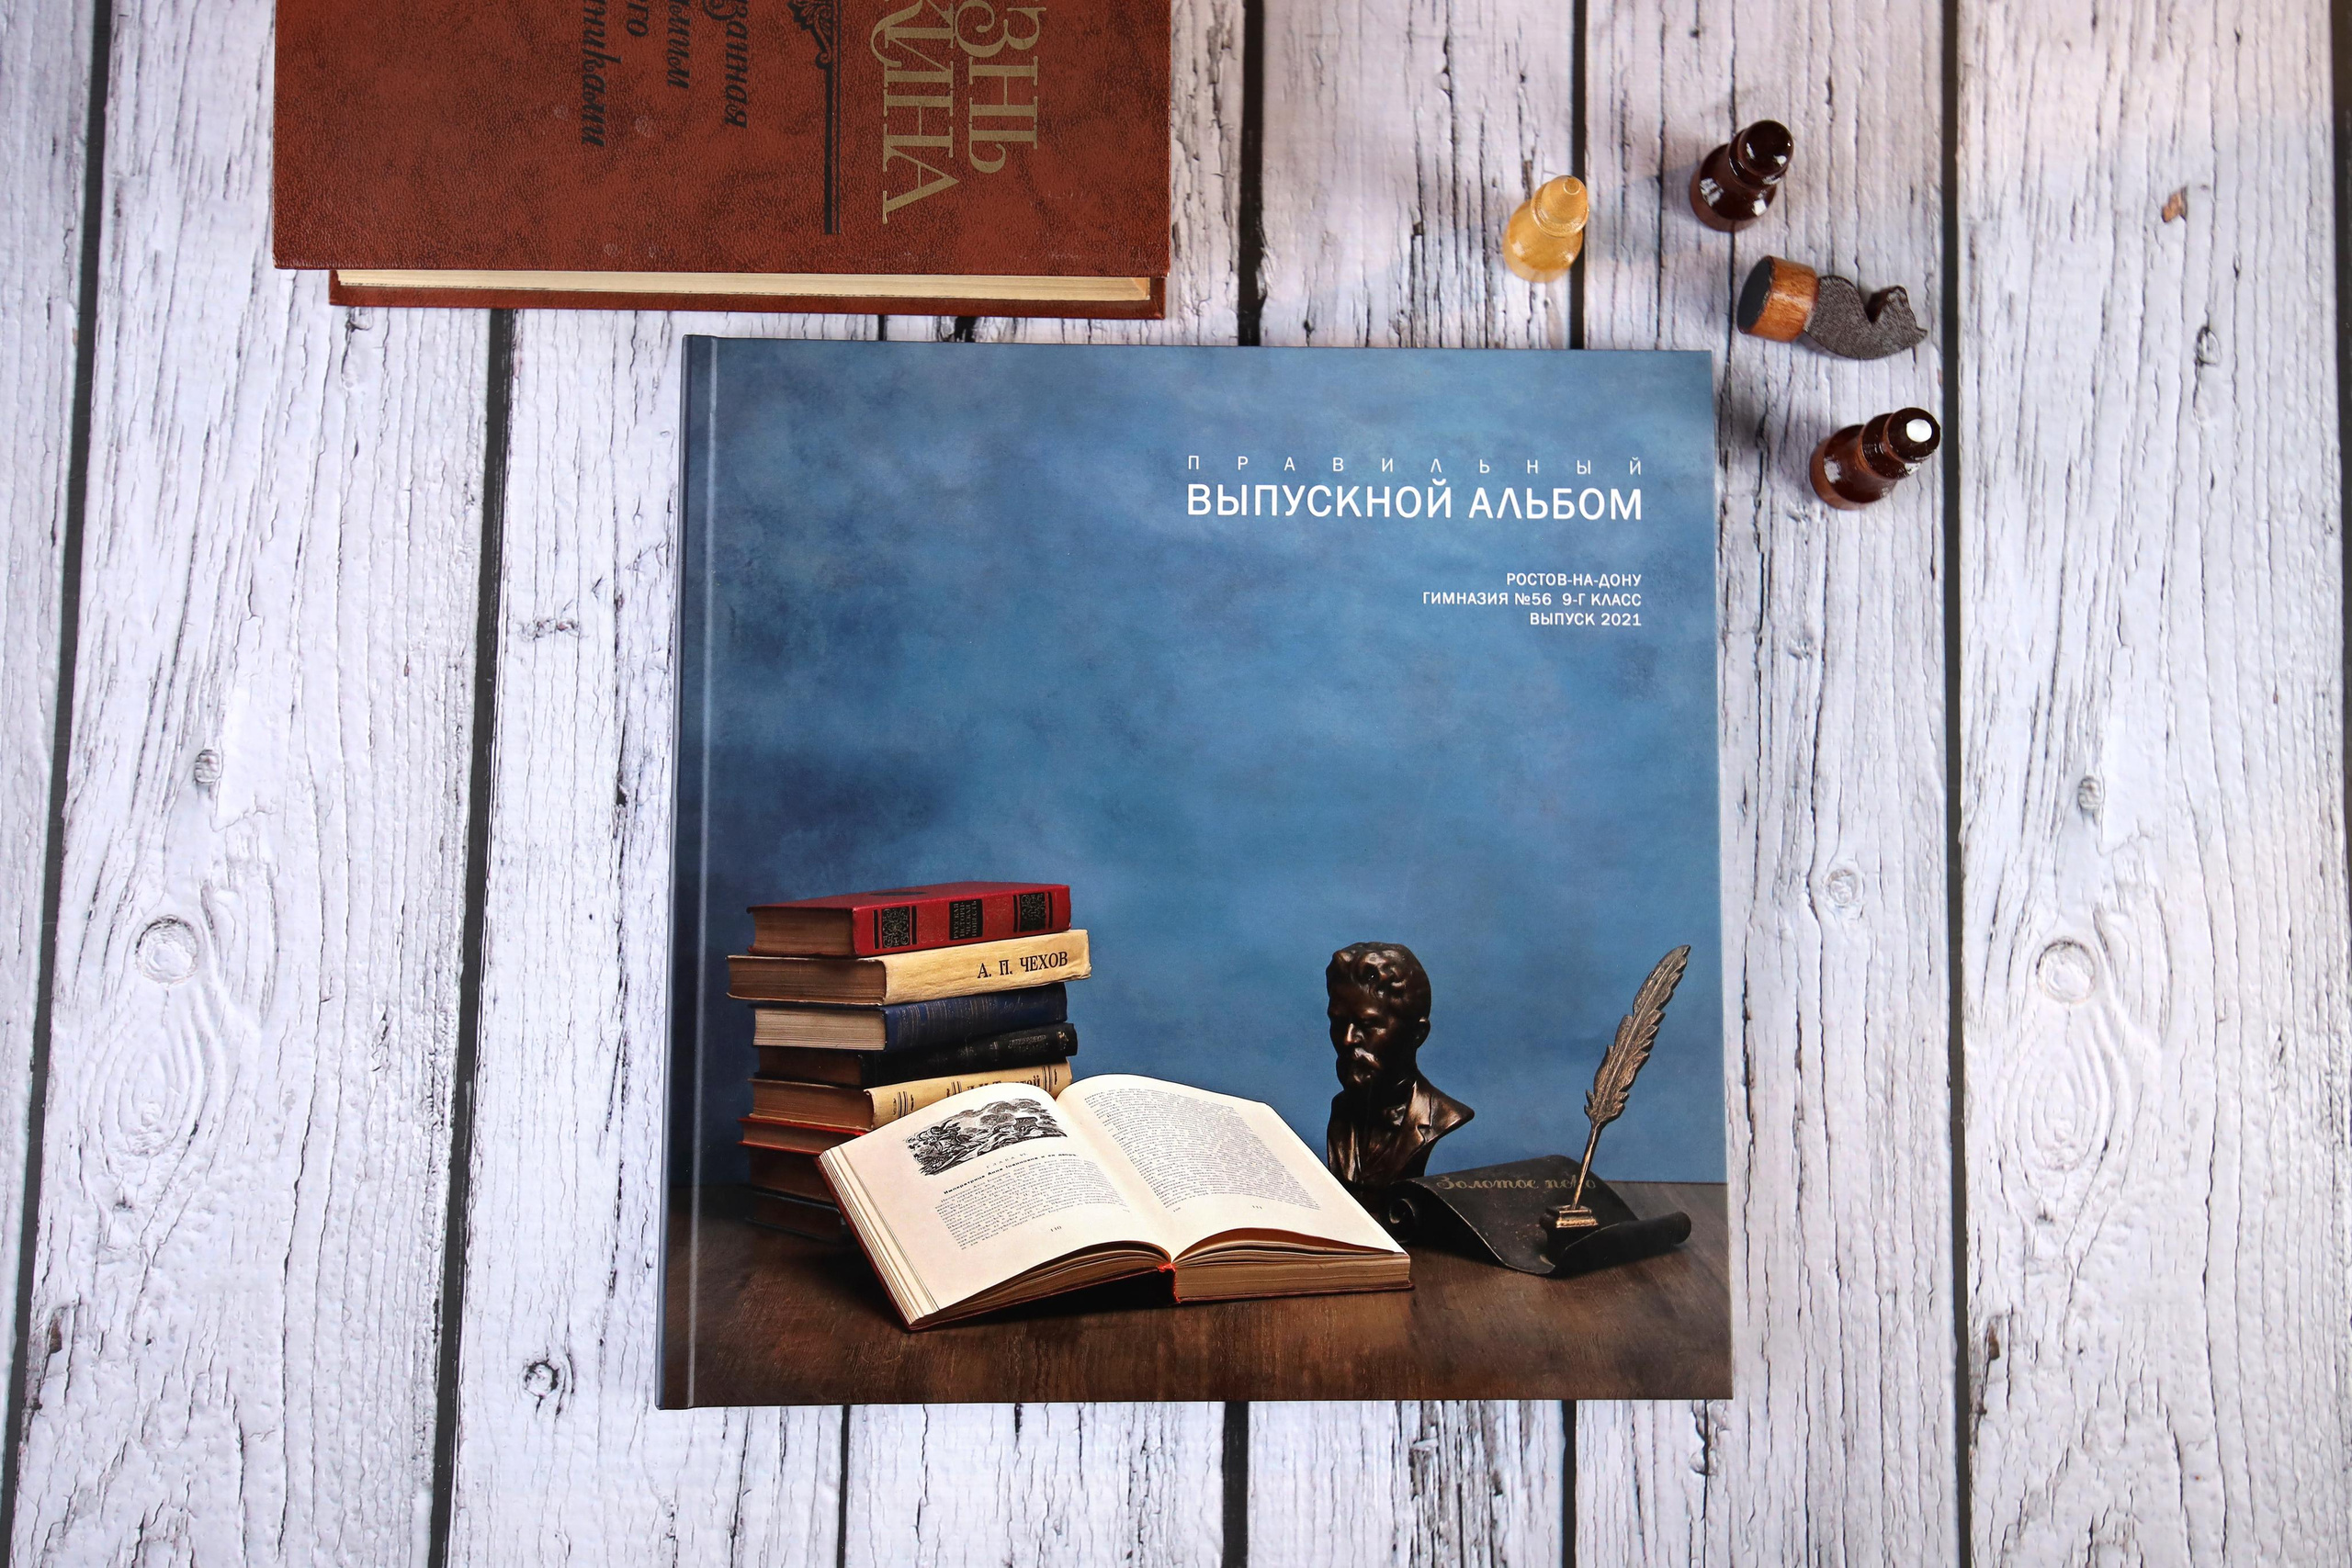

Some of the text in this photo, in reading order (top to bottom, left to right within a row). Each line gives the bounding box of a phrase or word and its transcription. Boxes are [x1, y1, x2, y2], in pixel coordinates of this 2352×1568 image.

[627, 0, 650, 38] го
[581, 0, 621, 147] никами
[955, 0, 1046, 174] ЗНЬ
[1187, 455, 1642, 476] ПРАВИЛЬНЫЙ
[1186, 478, 1643, 520] ВЫПУСКНОЙ АЛЬБОМ
[1506, 572, 1643, 588] РОСТОВ-НА-ДОНУ
[1422, 592, 1643, 607] ГИМНАЗИЯ №56 9-Г КЛАСС
[1529, 612, 1643, 626] ВЫПУСК 2021
[977, 951, 1068, 979] А. П. ЧЕХОВ
[1436, 1175, 1539, 1190] Золотое
